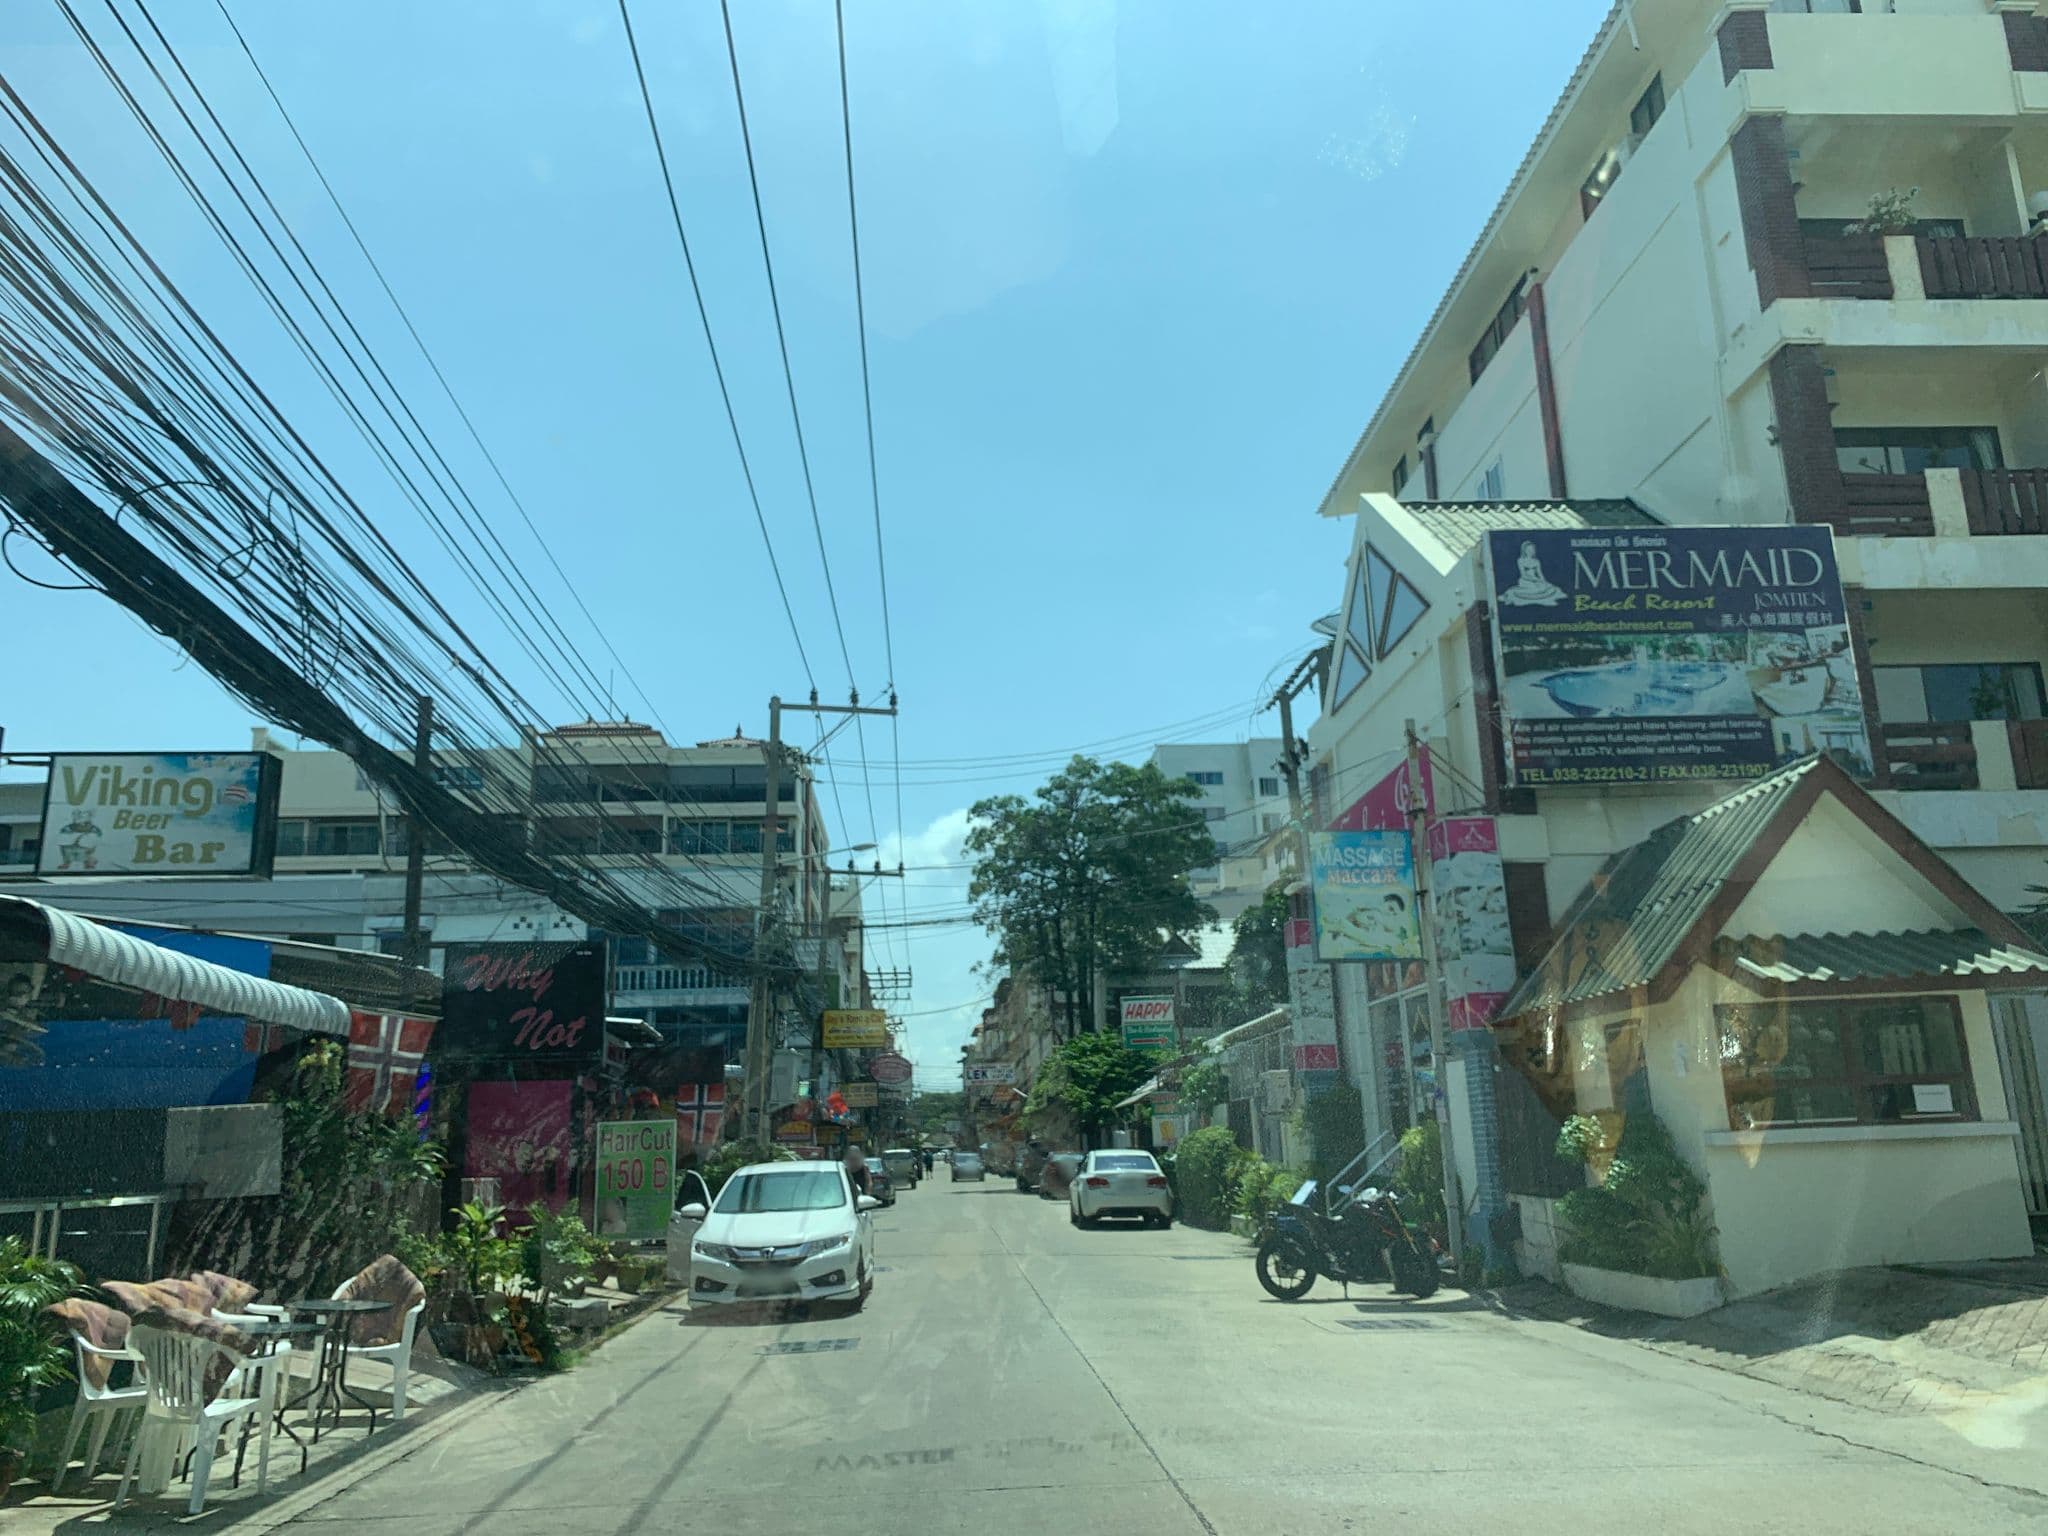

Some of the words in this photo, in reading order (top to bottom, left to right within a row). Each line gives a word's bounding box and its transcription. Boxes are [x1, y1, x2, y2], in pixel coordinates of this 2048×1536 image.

[1573, 547, 1824, 590] MERMAID
[1574, 593, 1637, 612] Beach
[1644, 593, 1717, 611] Resort
[1753, 590, 1827, 610] JOMTIEN
[62, 765, 214, 818] Viking
[112, 809, 172, 831] Beer
[131, 833, 227, 865] Bar
[1316, 846, 1405, 867] MASSAGE
[462, 950, 554, 1001] Why
[1124, 1002, 1172, 1020] HAPPY
[509, 1006, 587, 1050] Not
[604, 1159, 644, 1191] 150
